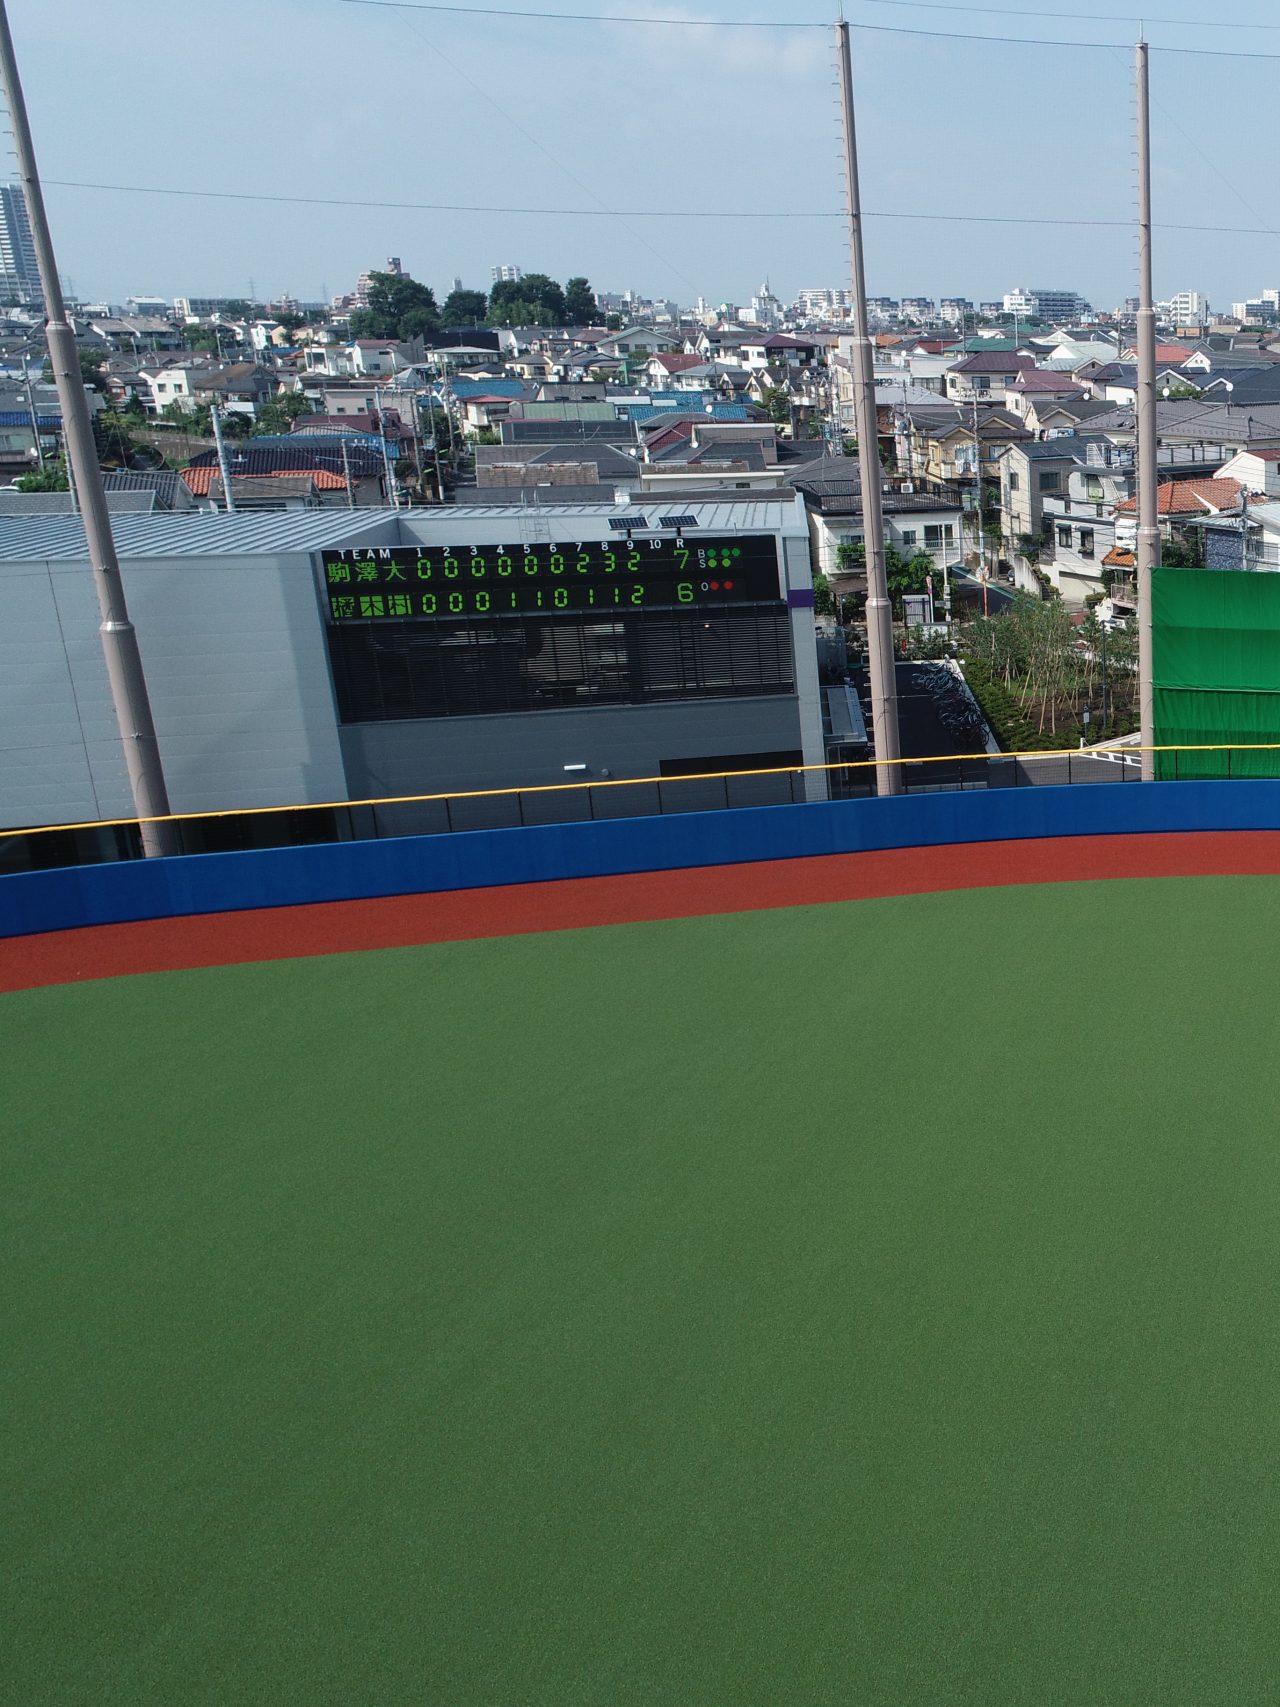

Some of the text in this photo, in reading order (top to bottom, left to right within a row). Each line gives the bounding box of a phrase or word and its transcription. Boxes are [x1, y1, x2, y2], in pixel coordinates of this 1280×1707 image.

[338, 539, 684, 560] TEAM 1 2 3 4 5 6 7 8 9 10 R
[697, 549, 705, 558] B
[327, 549, 689, 583] 駒澤大 0 0 0 0 0 0 2 3 2 7
[699, 559, 707, 568] S
[422, 593, 437, 614] 0
[449, 592, 463, 612] 0
[475, 591, 490, 611] 0
[554, 588, 568, 608] 0
[631, 584, 645, 604] 2
[677, 582, 694, 602] 6
